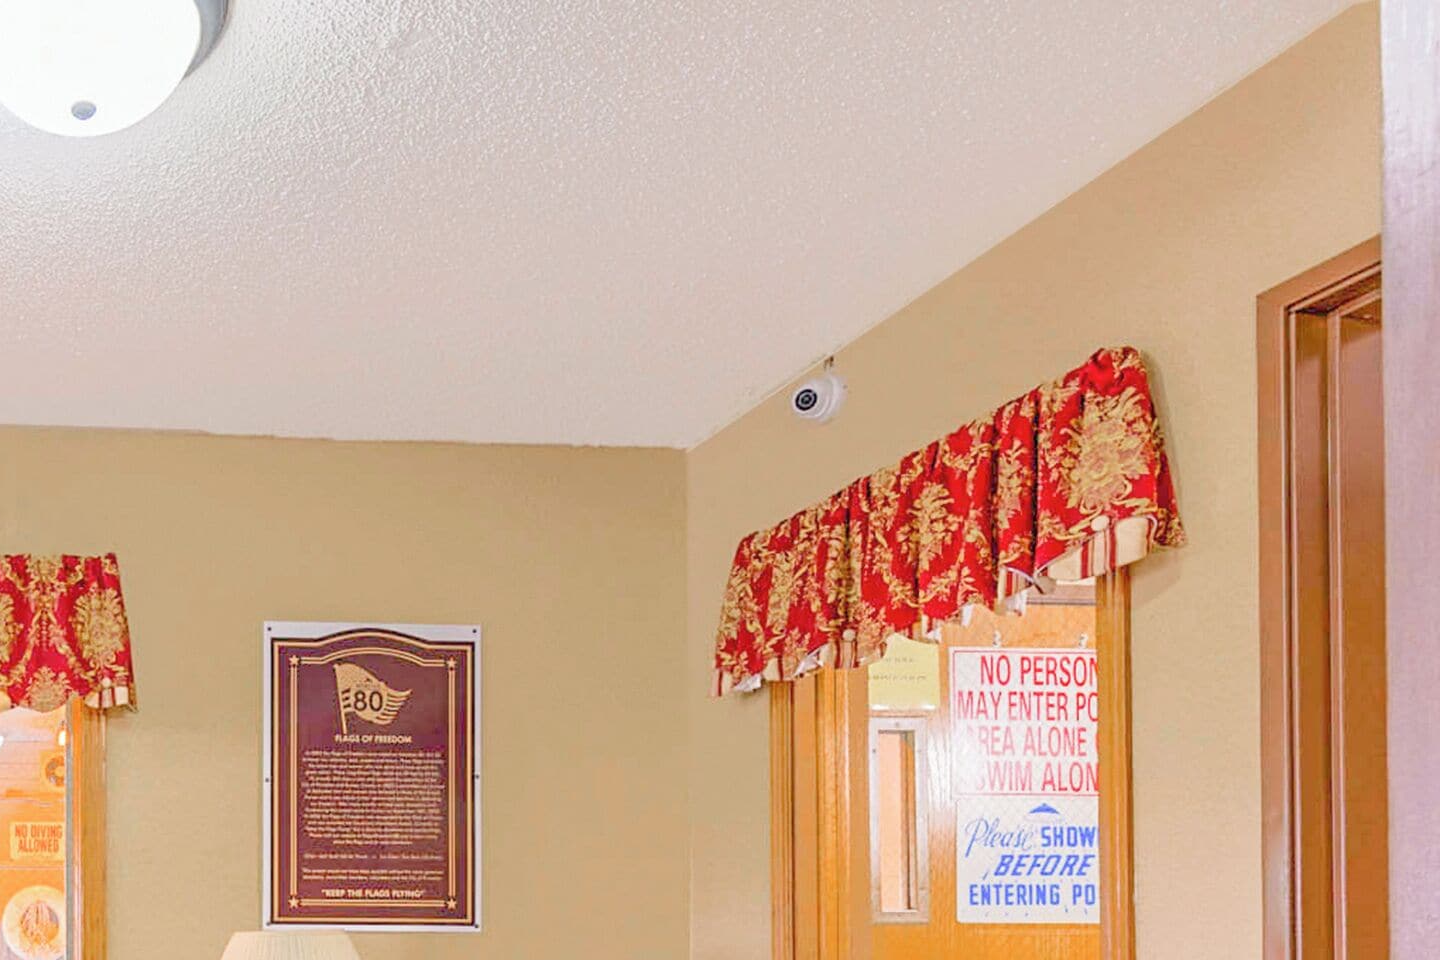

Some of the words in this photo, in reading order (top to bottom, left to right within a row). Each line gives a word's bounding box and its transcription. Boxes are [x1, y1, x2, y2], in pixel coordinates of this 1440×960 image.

[980, 654, 1011, 686] NO
[354, 689, 383, 712] 80
[957, 689, 1002, 721] MAY
[1007, 690, 1068, 722] ENTER
[361, 735, 373, 743] OF
[374, 735, 412, 744] FREEDOM
[1023, 725, 1087, 757] ALONE
[15, 823, 28, 838] NO
[30, 824, 63, 839] DIVING
[964, 817, 1035, 858] Please
[1041, 826, 1096, 848] SHOW
[18, 839, 60, 853] ALLOWED
[993, 854, 1096, 876] BEFORE
[347, 889, 363, 898] THE
[969, 884, 1060, 906] ENTERING
